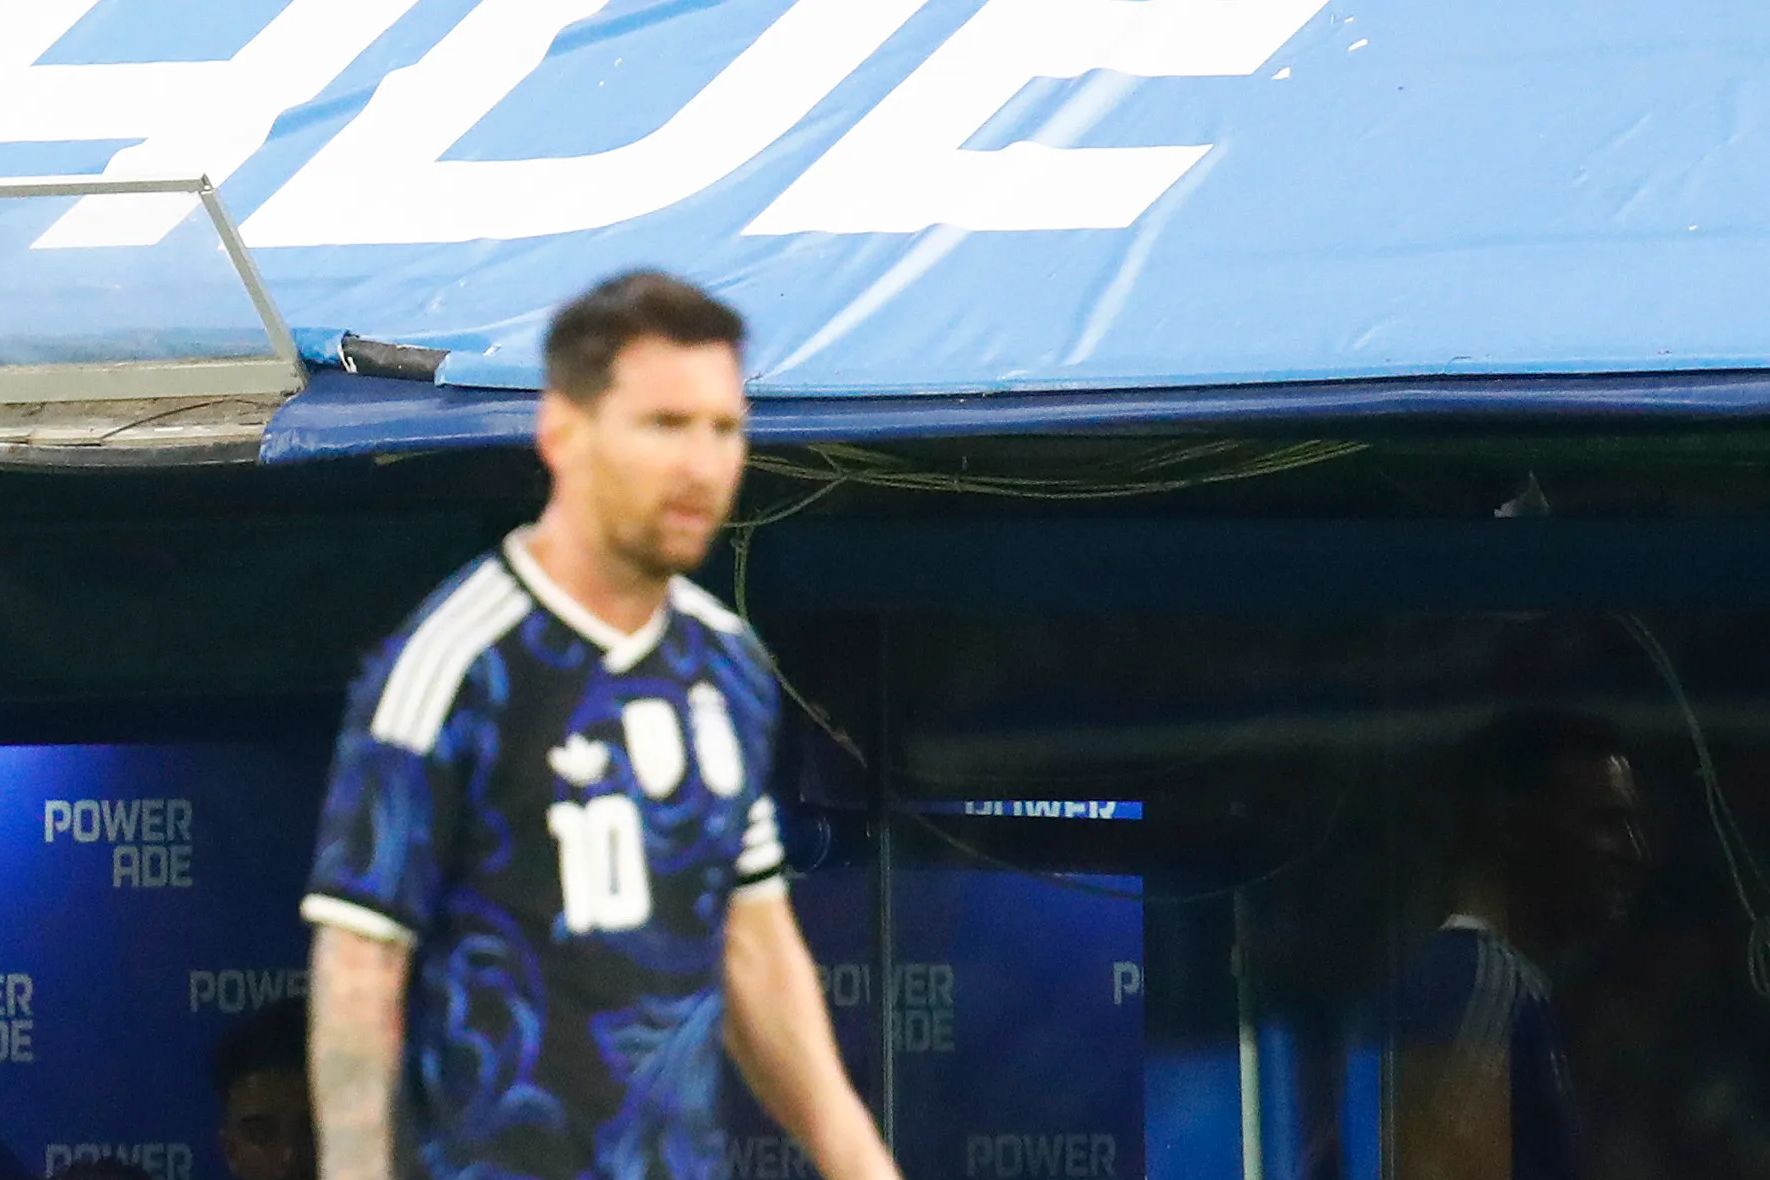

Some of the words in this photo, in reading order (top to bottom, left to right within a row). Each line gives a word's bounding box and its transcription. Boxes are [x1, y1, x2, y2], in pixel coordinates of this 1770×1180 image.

[43, 799, 193, 845] POWER
[112, 846, 193, 888] ADE
[546, 793, 651, 934] 10
[966, 1133, 1117, 1179] POWER
